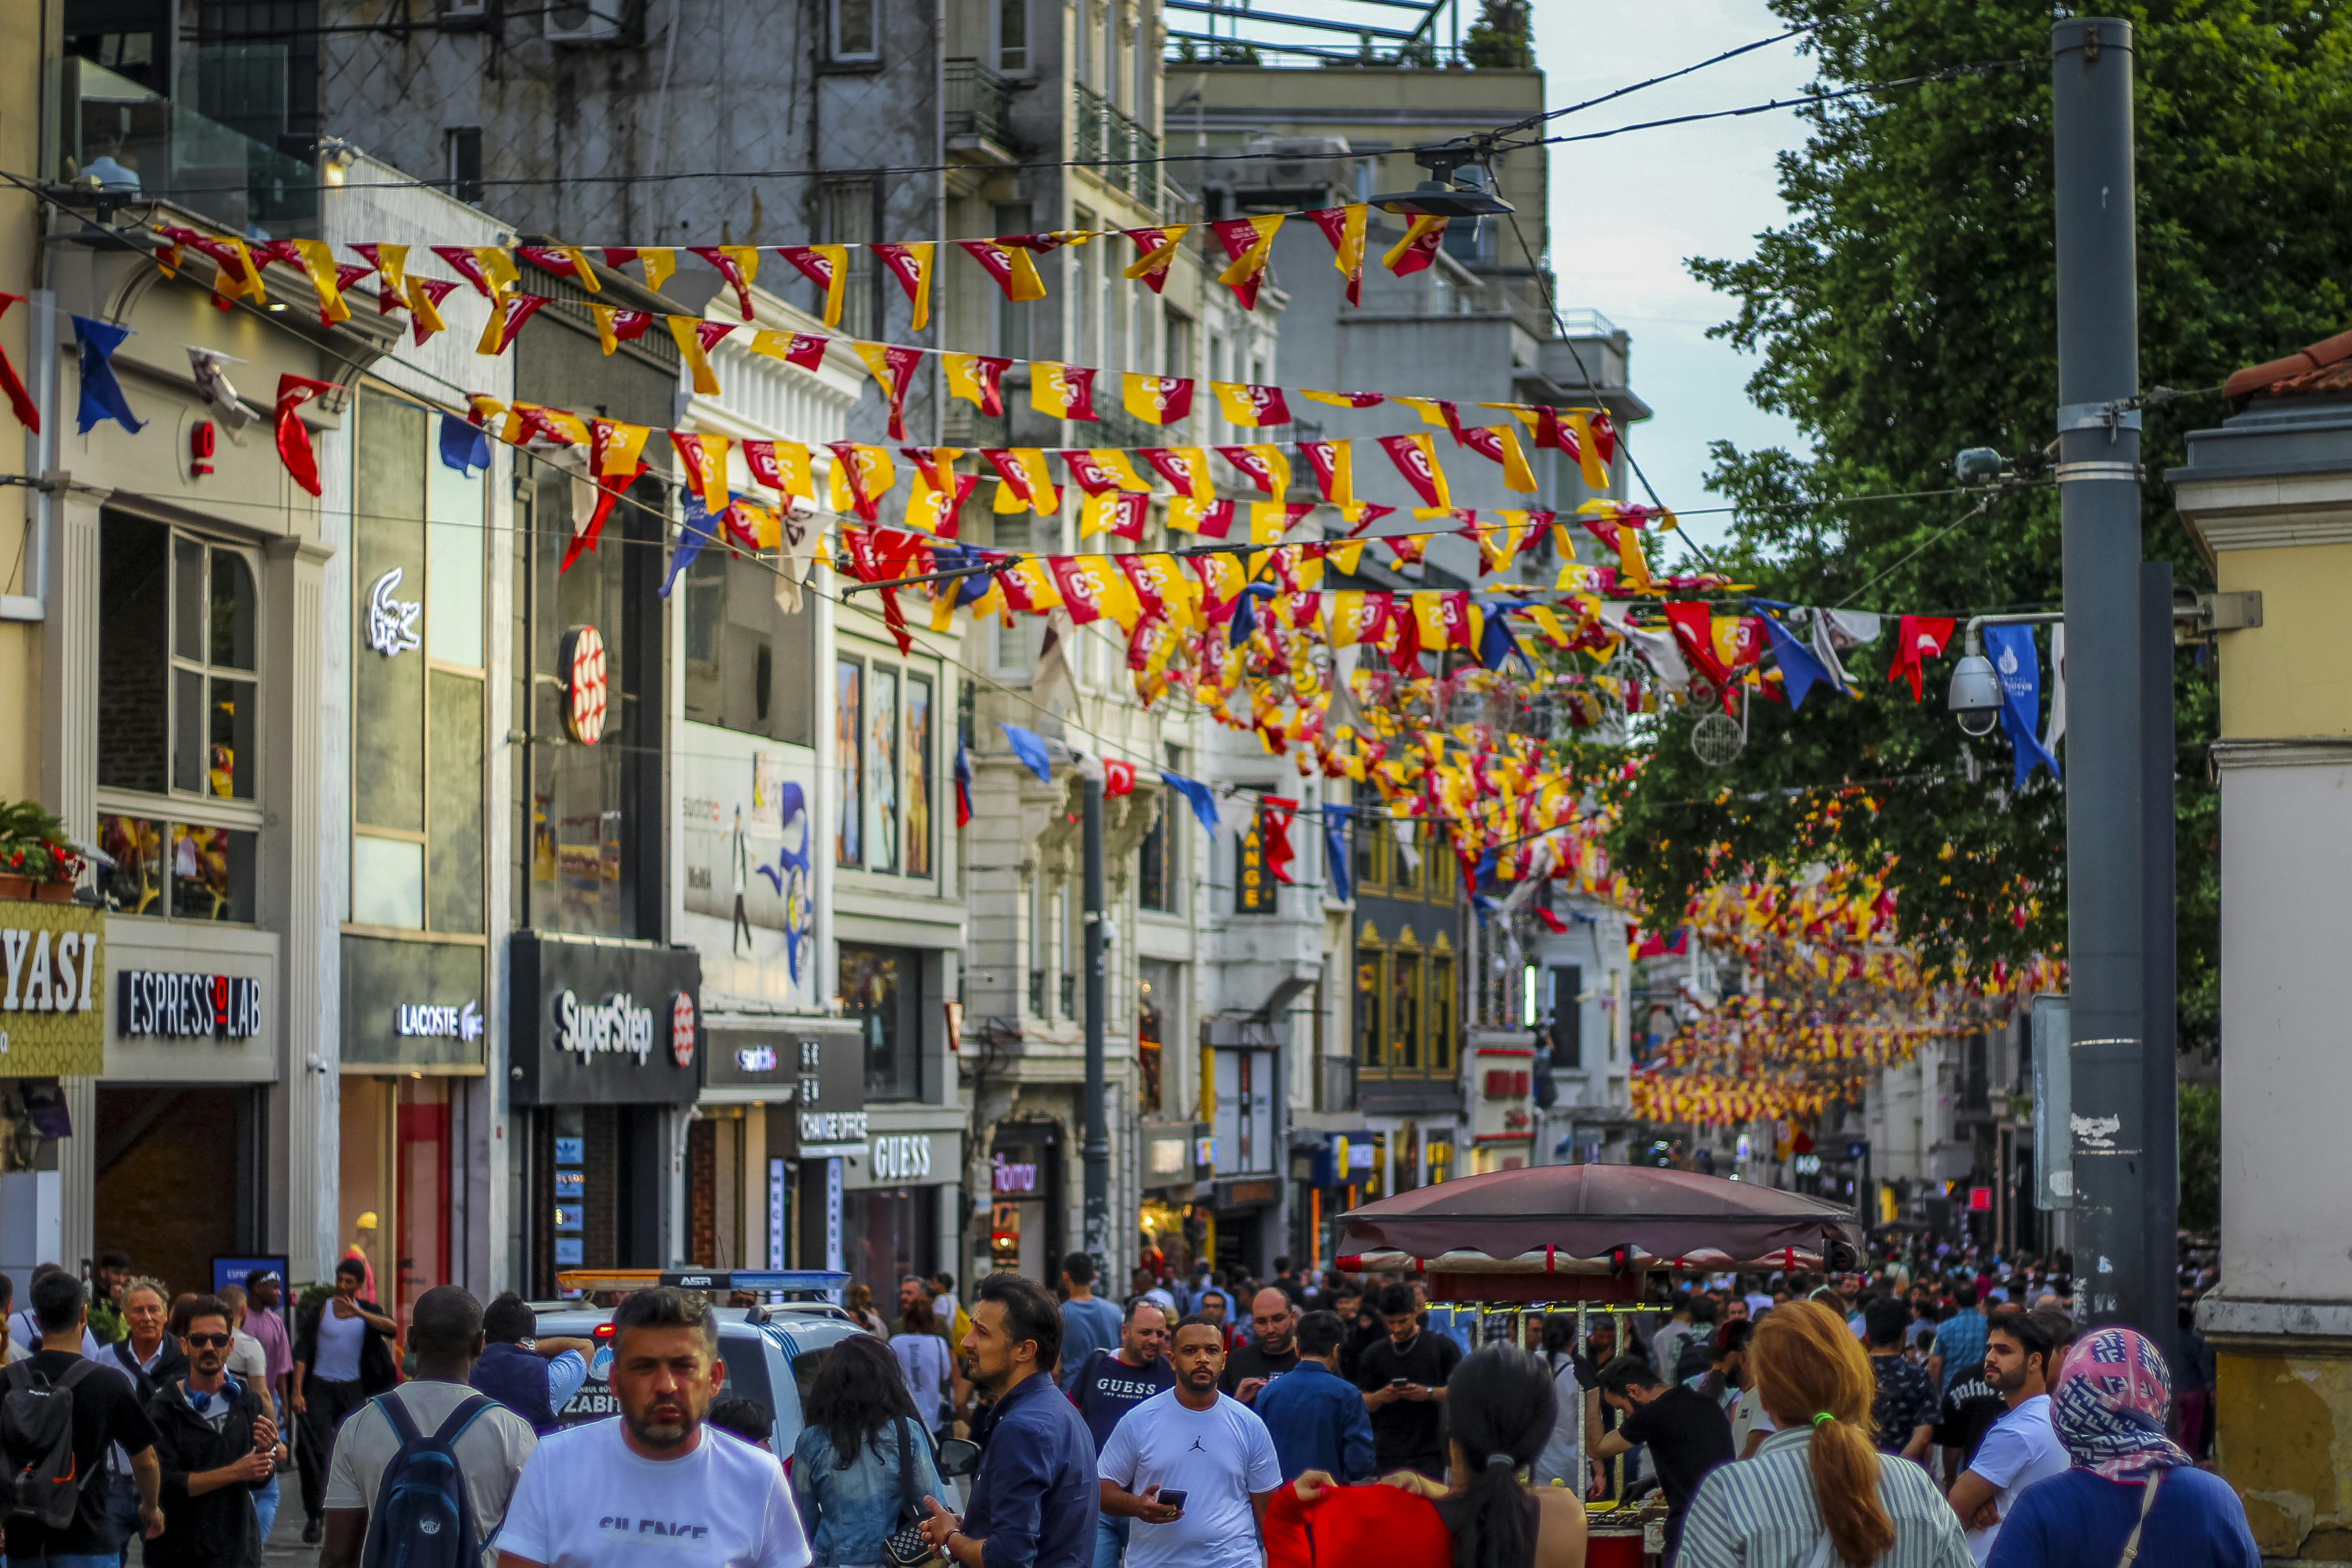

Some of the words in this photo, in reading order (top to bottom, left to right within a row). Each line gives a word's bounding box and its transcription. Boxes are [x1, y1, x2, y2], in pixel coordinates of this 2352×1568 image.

[1099, 501, 1132, 526] 23
[1347, 605, 1376, 628] 23
[1428, 602, 1457, 627] 23
[1723, 625, 1750, 646] 23
[1243, 794, 1261, 908] ANGE
[0, 929, 97, 1010] YASI
[130, 970, 261, 1036] ESPRESSOLAB
[401, 1003, 458, 1036] LACOSTE
[561, 989, 654, 1066] SuperStep
[874, 1135, 931, 1178] GUESS
[680, 1276, 712, 1285] ASR
[1097, 1378, 1156, 1395] GUESS
